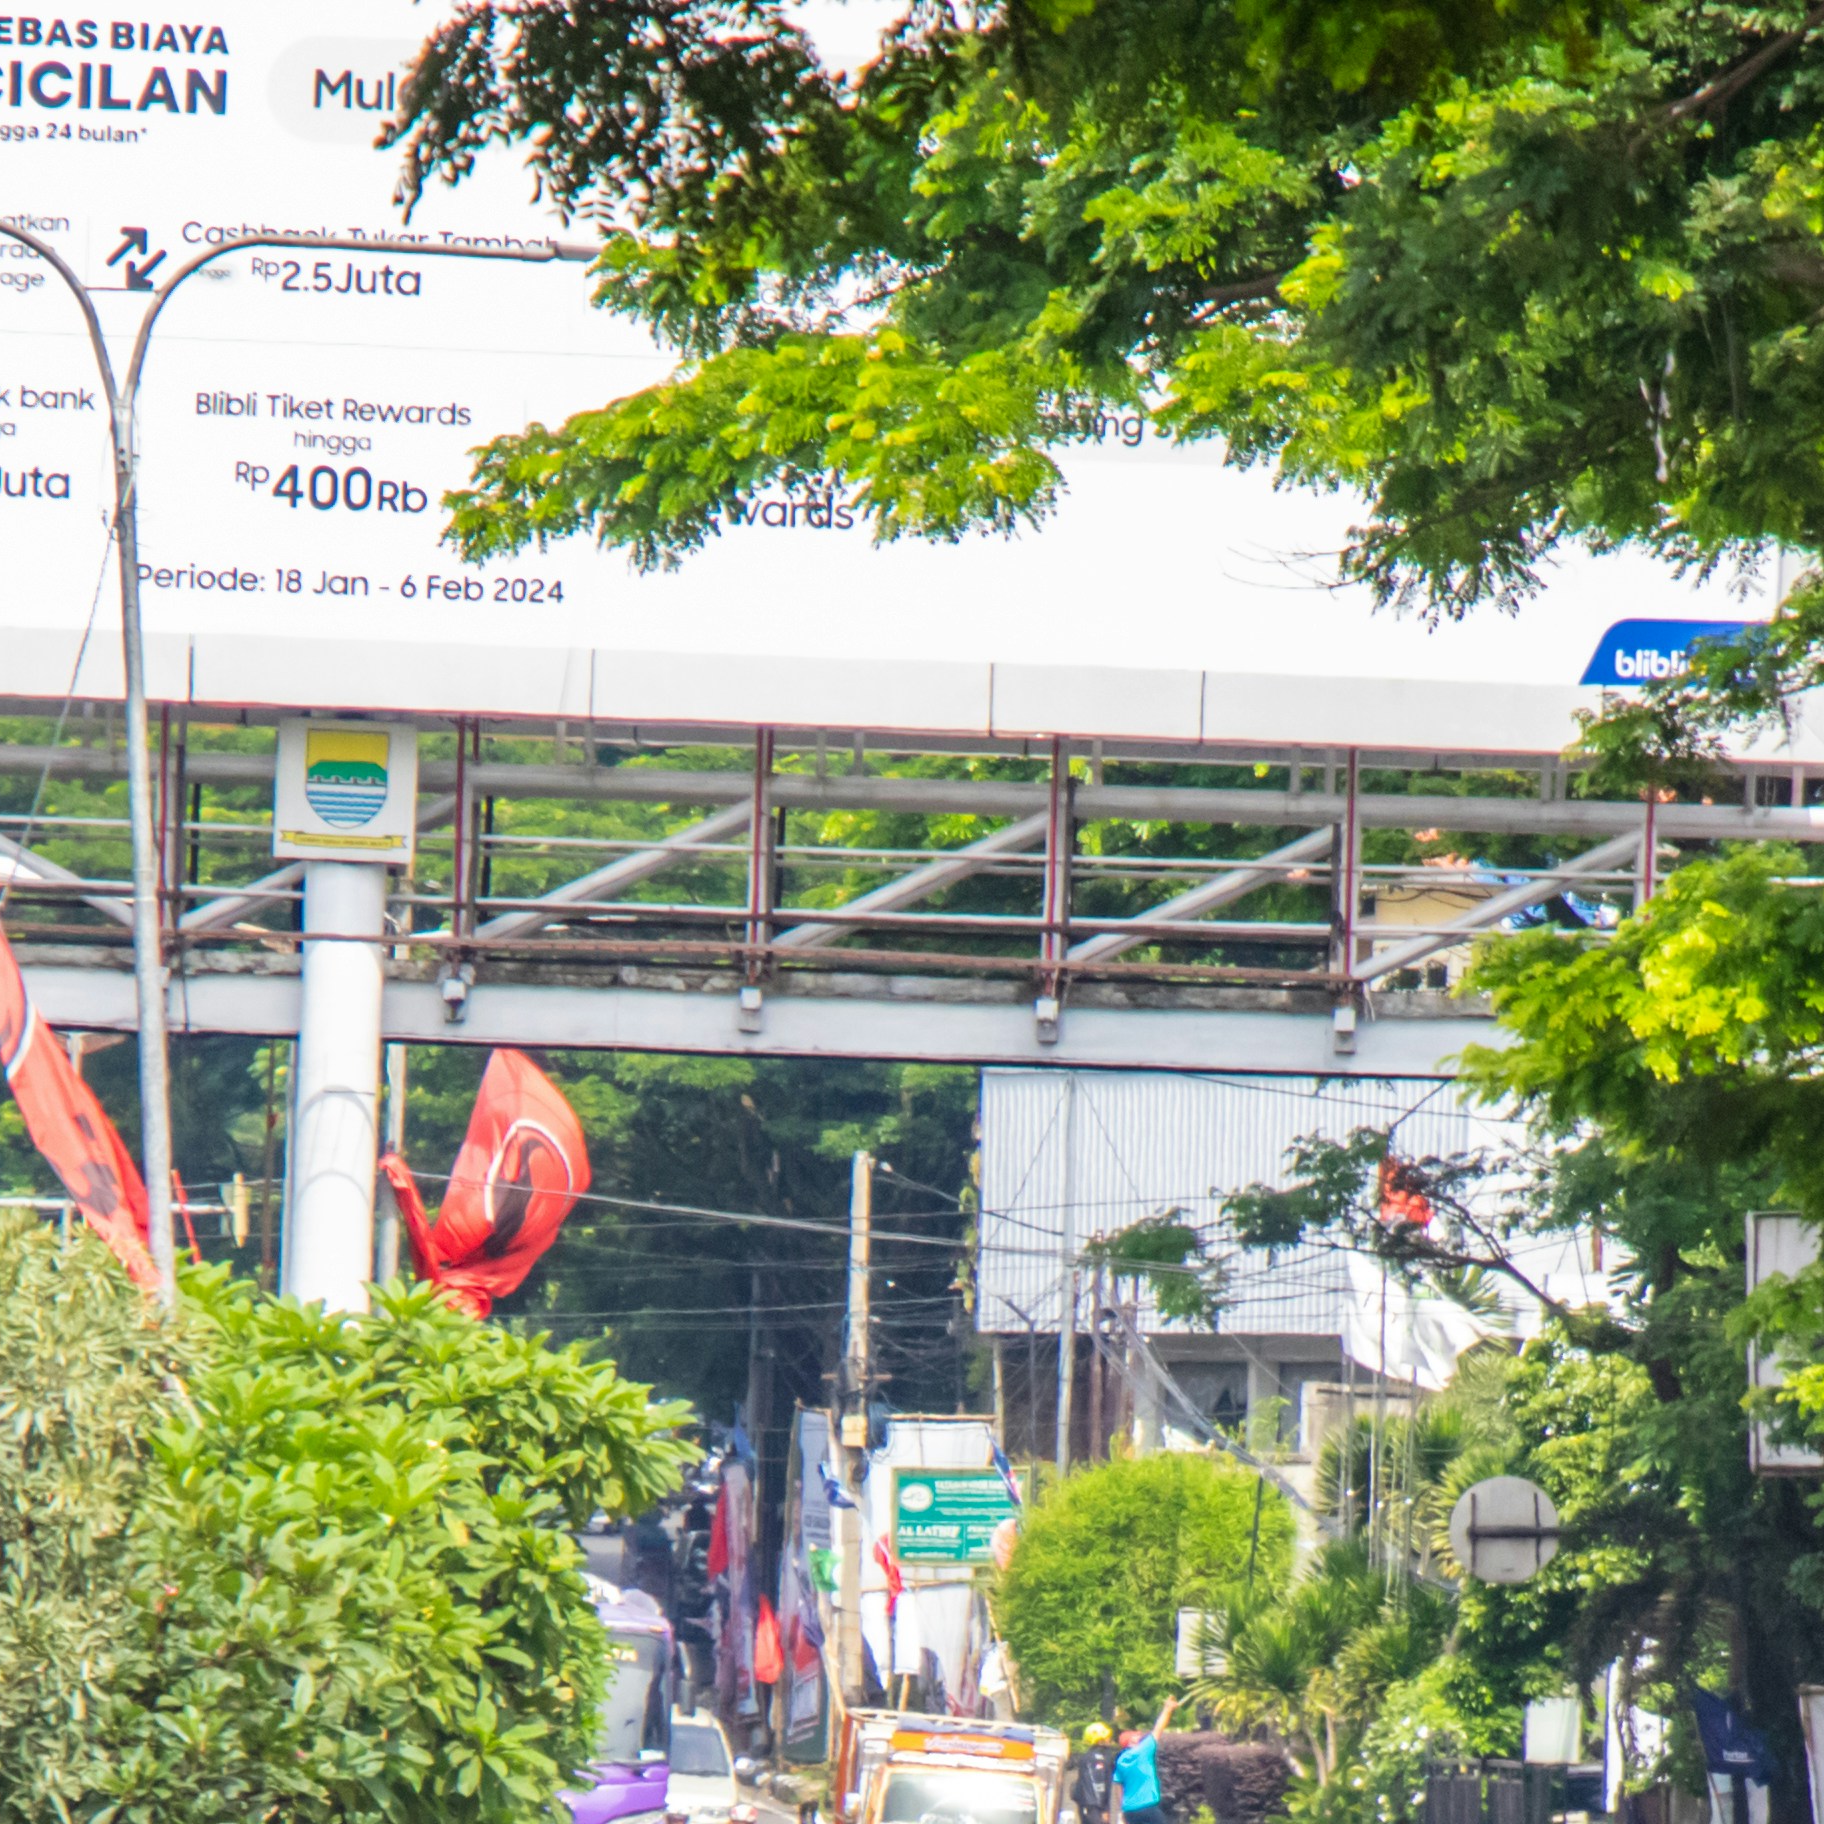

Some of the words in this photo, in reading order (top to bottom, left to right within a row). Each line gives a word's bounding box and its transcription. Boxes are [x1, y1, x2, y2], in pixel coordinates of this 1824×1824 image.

[110, 21, 230, 56] BIAYA
[313, 68, 395, 112] Mul
[46, 123, 73, 141] 24
[20, 384, 96, 411] bank
[195, 391, 258, 419] Blibli
[267, 394, 334, 421] Tiket
[343, 398, 472, 426] Rewards
[294, 430, 372, 456] hingga
[136, 563, 266, 594] Periode:
[276, 569, 302, 594] 18
[312, 571, 370, 596] Jan
[400, 574, 417, 599] 6
[427, 574, 484, 602] Feb
[493, 577, 565, 604] 2024
